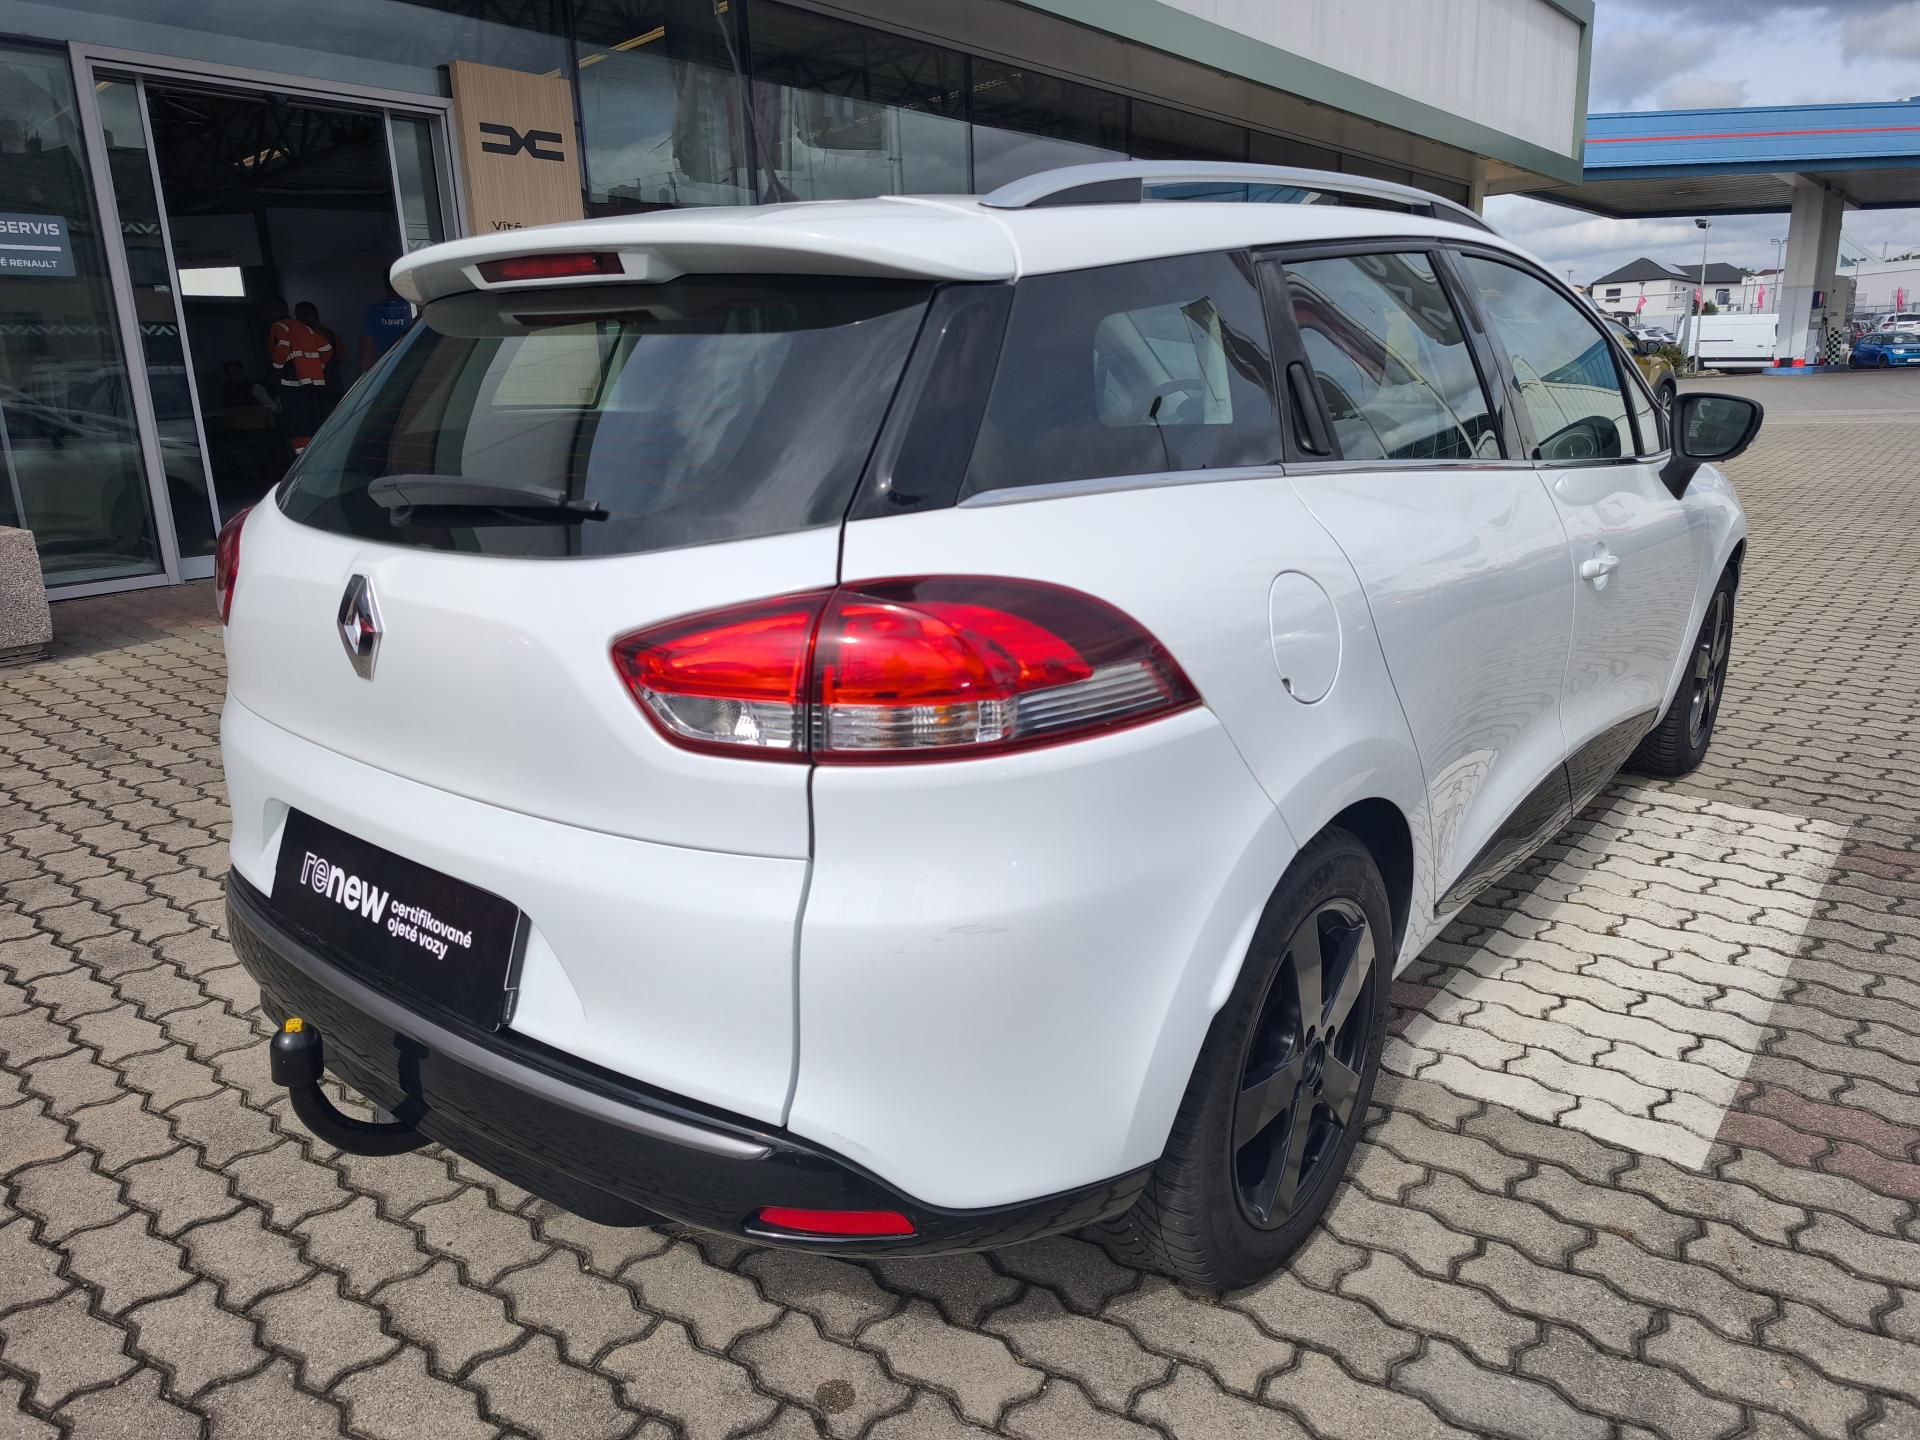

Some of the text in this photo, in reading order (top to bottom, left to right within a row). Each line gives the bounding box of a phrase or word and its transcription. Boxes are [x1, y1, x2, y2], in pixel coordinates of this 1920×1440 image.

[0, 221, 59, 235] SERVIS
[9, 259, 57, 268] RENAULT
[300, 851, 389, 923] renew
[387, 918, 449, 960] ojeté vozy
[391, 900, 472, 948] certifikované
